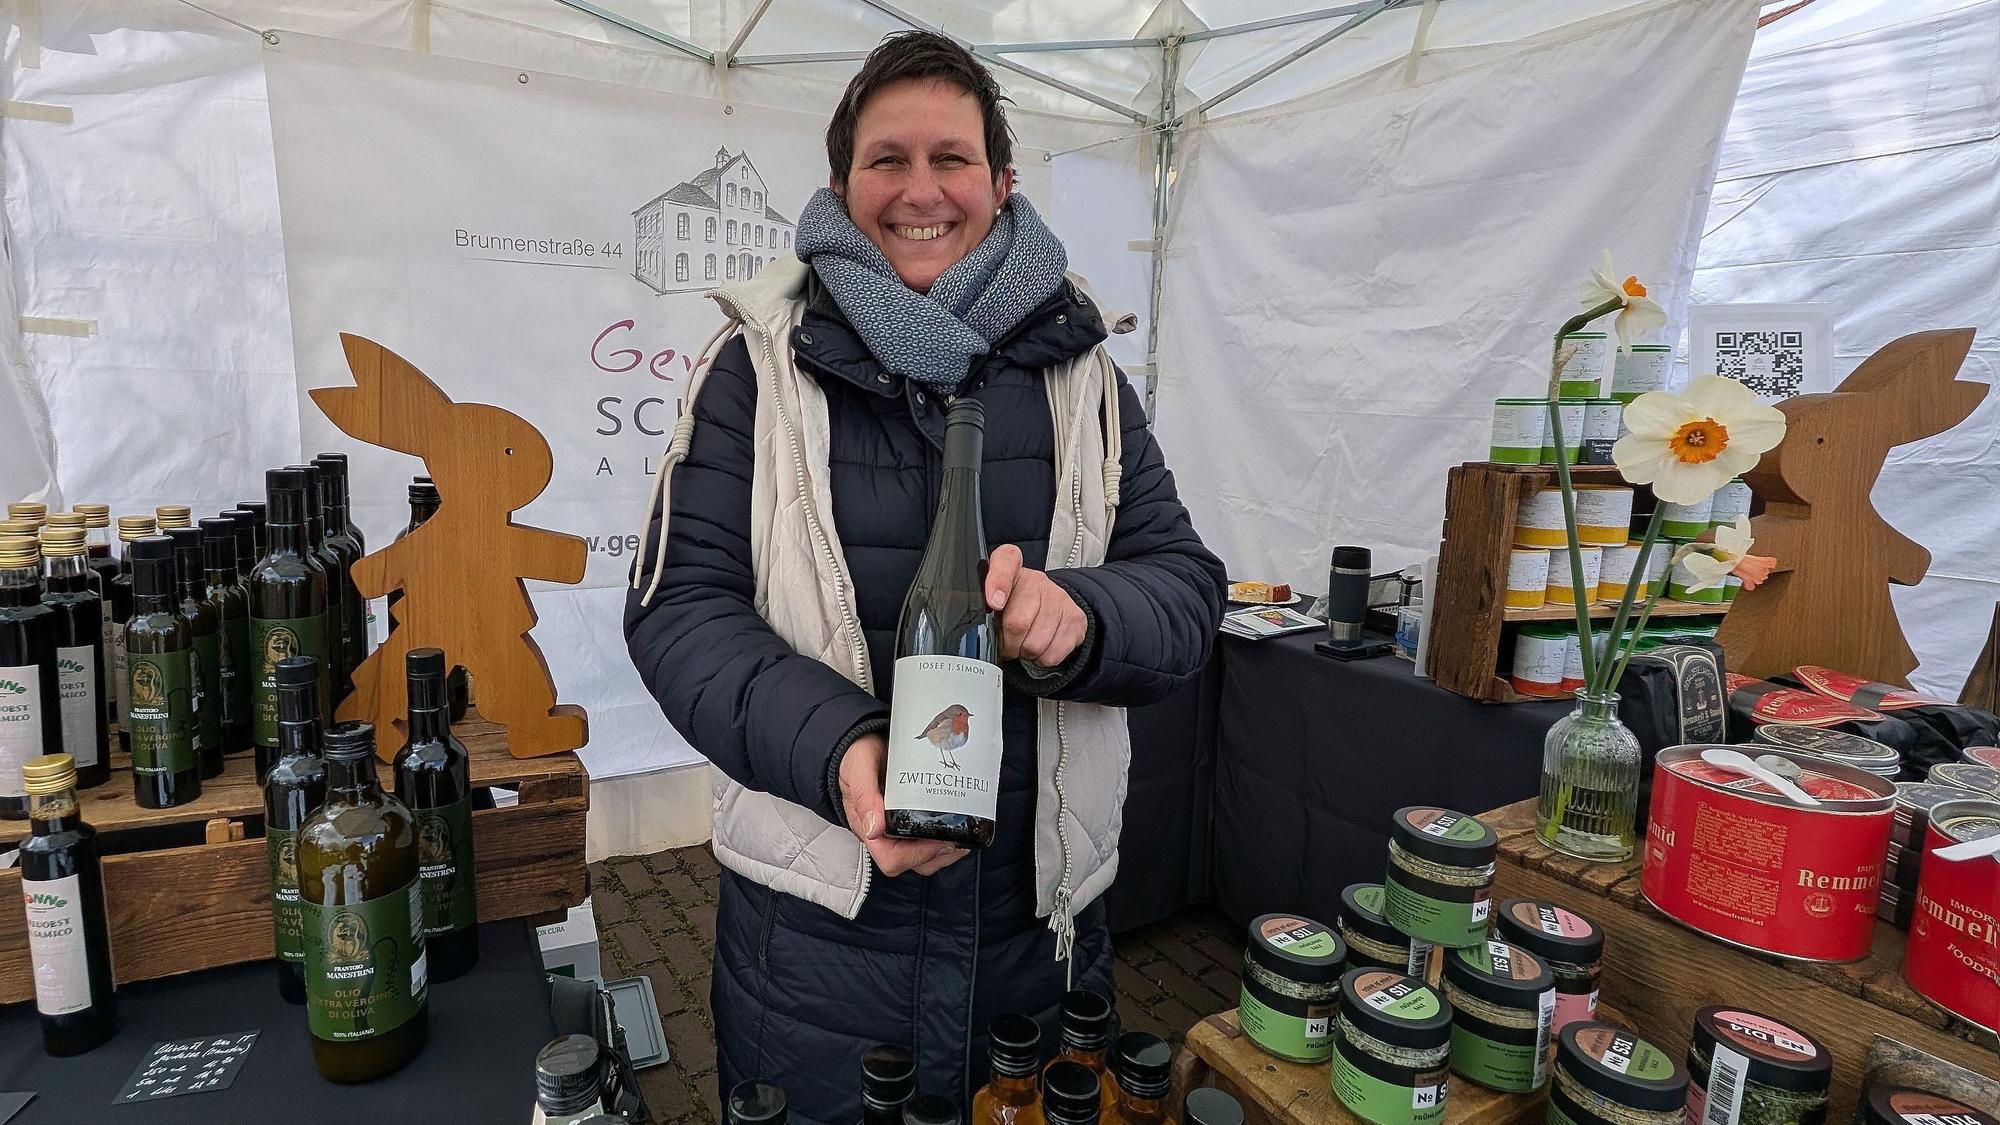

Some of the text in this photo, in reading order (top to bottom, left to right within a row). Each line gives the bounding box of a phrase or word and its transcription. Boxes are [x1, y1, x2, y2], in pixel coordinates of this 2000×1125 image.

[455, 229, 623, 259] Brunnenstraße 44
[596, 396, 682, 436] SC
[919, 661, 945, 671] JOSEF
[956, 663, 985, 676] SIMON
[899, 772, 989, 793] ZWITSCHERLI
[925, 787, 966, 798] WEISSWEIN
[1650, 818, 1676, 849] mid
[547, 926, 565, 936] CURA
[326, 967, 375, 980] MANESTRINI
[333, 964, 364, 973] FRANTOIO
[334, 988, 361, 999] OLIO
[341, 1006, 375, 1020] OLIVA
[347, 1027, 375, 1038] ITALIANO
